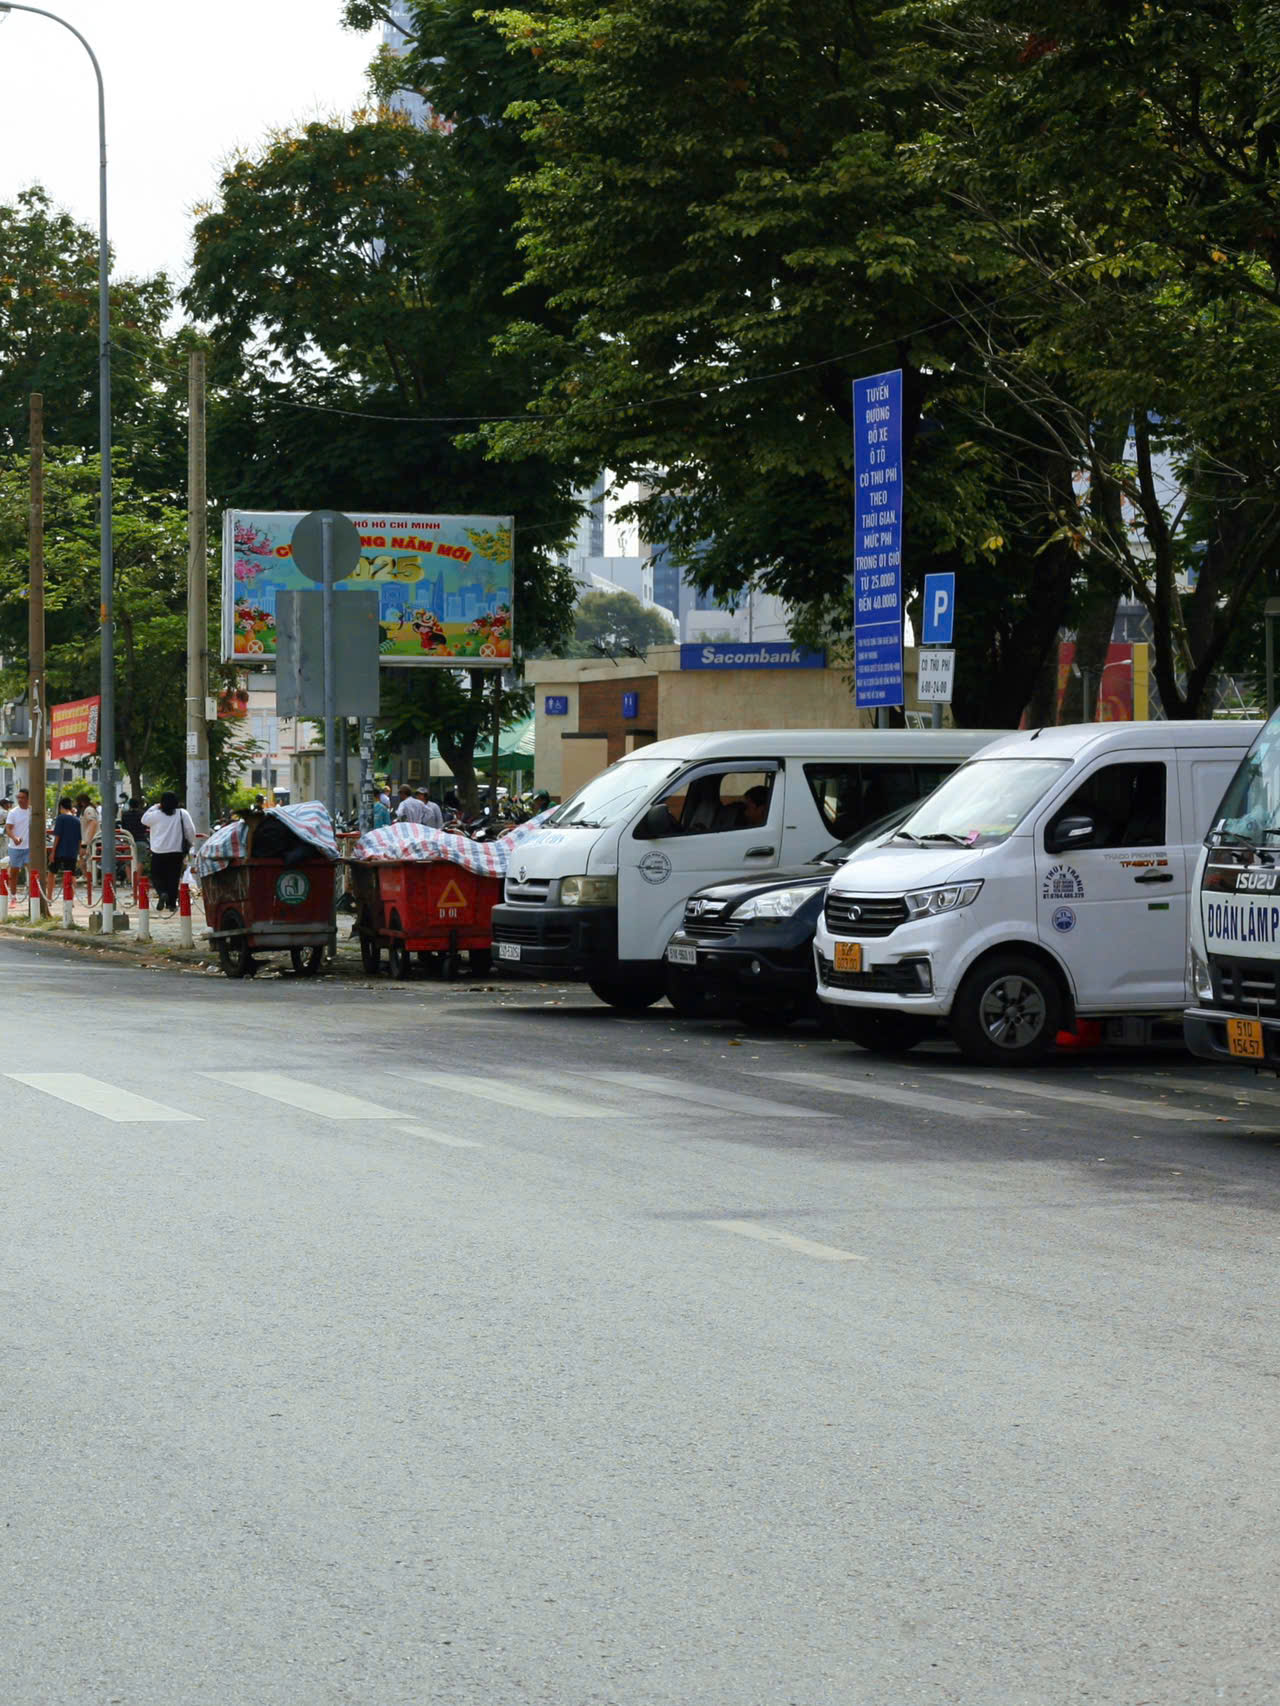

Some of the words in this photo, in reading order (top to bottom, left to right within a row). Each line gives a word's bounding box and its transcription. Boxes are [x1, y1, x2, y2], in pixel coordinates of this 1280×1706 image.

[866, 380, 889, 402] TUYẾN
[866, 403, 890, 424] ĐƯỜNG
[879, 427, 888, 442] XE
[870, 469, 884, 486] THU
[885, 463, 897, 483] PHÍ
[870, 490, 888, 506] THEO
[411, 522, 441, 530] MINH
[864, 529, 879, 549] MỨC
[880, 527, 892, 547] PHÍ
[391, 535, 433, 552] NĂM
[436, 543, 473, 563] MỚI
[344, 554, 425, 583] 025
[856, 554, 877, 571] TRONG
[933, 590, 949, 627] P
[701, 645, 801, 664] Sacombank
[1235, 873, 1277, 890] ISUZU
